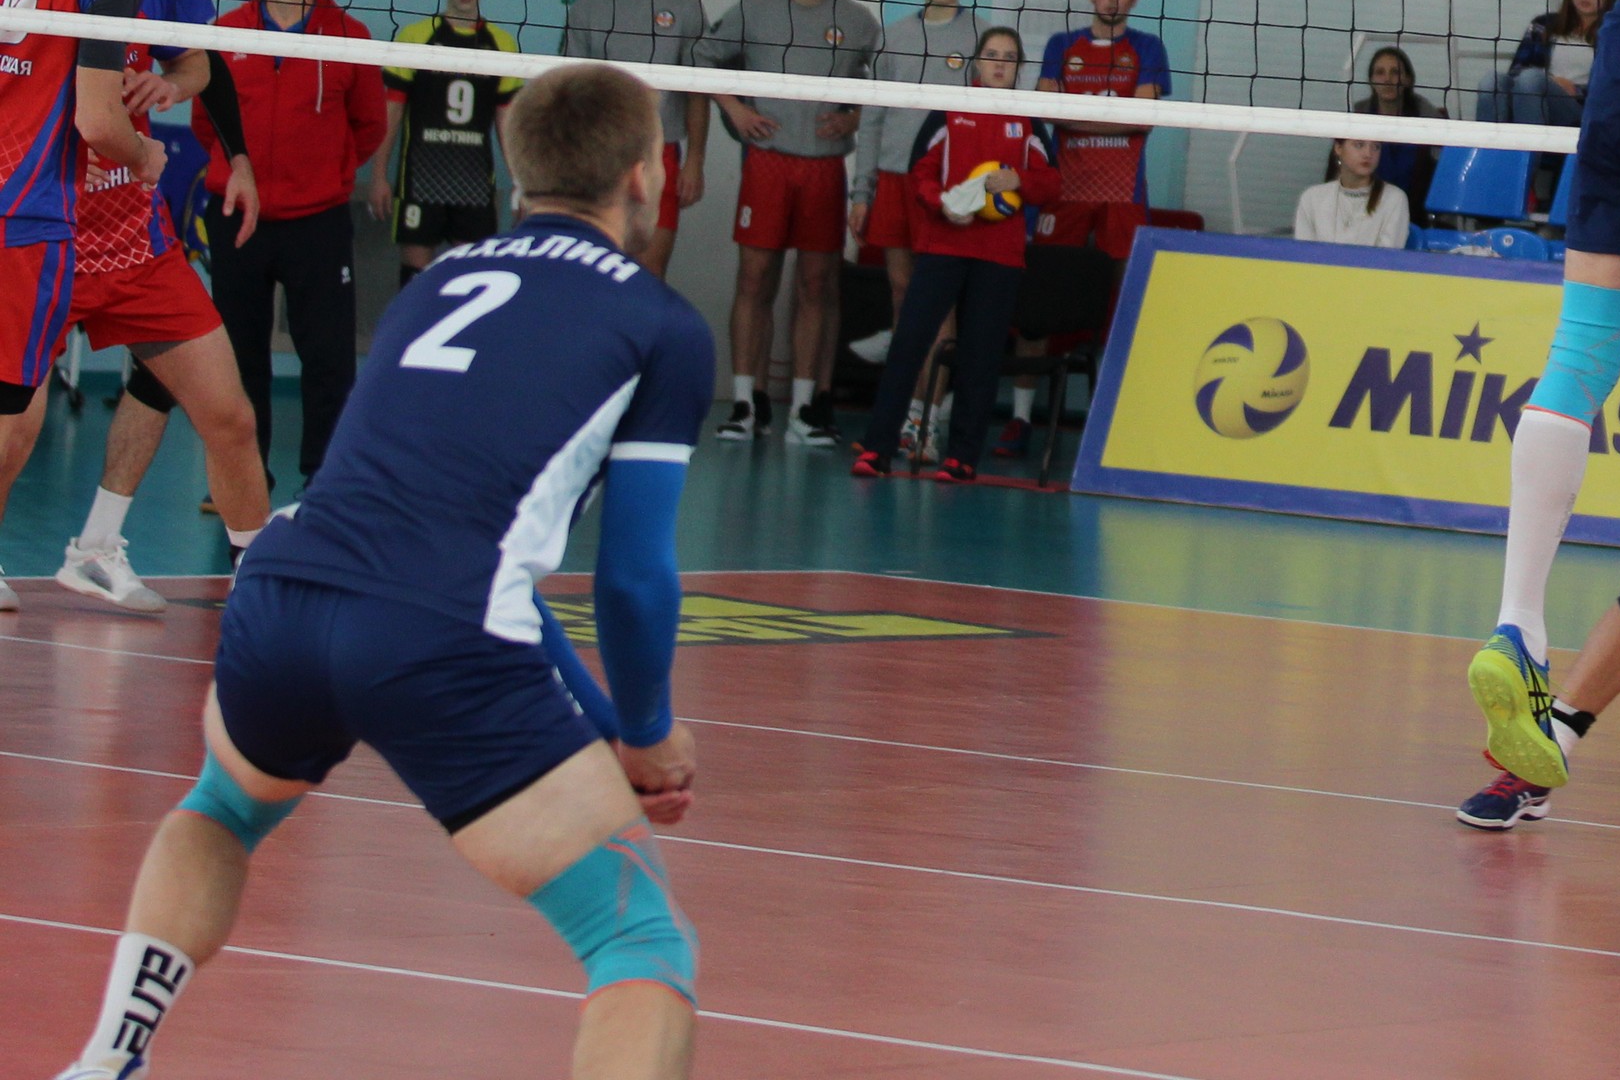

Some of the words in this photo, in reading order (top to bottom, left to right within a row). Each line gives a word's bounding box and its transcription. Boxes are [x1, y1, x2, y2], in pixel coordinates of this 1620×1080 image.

[447, 80, 475, 125] 9
[405, 204, 421, 229] 9
[400, 270, 522, 373] 2
